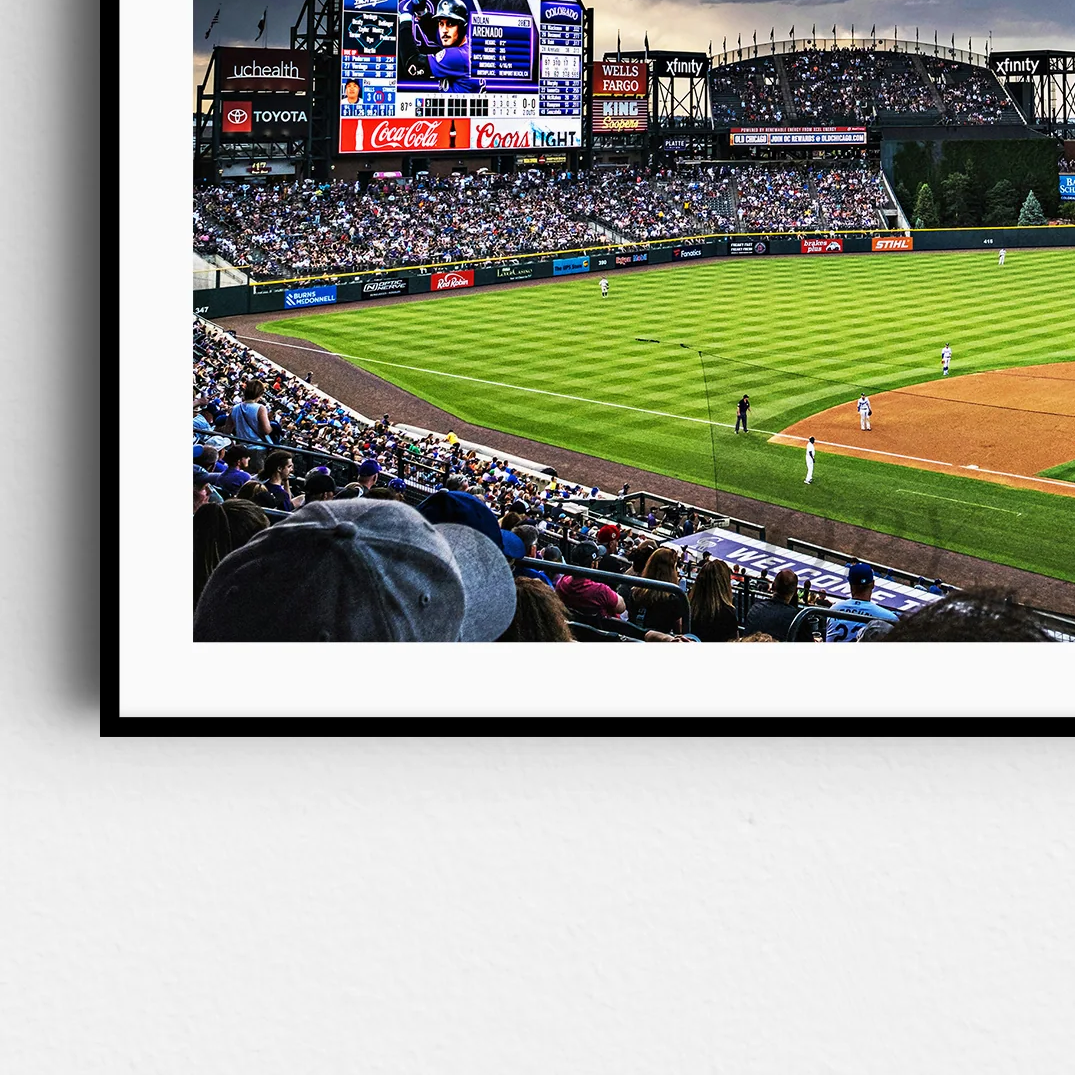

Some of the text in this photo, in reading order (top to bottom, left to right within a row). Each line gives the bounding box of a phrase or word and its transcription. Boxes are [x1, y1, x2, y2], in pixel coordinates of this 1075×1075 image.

[545, 6, 579, 21] COLORADO
[473, 17, 490, 25] NOLAN
[472, 27, 503, 38] ARENADO
[234, 60, 299, 79] uchealth
[602, 64, 639, 77] WELLS
[666, 58, 703, 77] xfinity
[996, 57, 1040, 75] xfinity
[602, 79, 639, 92] FARGO
[366, 92, 393, 102] 3 8
[522, 98, 536, 109] 0-0
[602, 101, 639, 116] KING
[253, 111, 308, 123] TOYOTA
[602, 116, 639, 132] Soopers
[371, 121, 442, 149] Coca-Cola
[476, 122, 577, 149] Coors LIGHT
[745, 135, 767, 143] CHICAGO
[770, 135, 783, 143] JOIN
[821, 134, 864, 142] OLDCHICAGO.COM
[875, 240, 909, 250] STIHL
[632, 253, 648, 262] Mobil
[680, 249, 702, 258] Fanatics
[437, 278, 469, 289] Red Robin
[293, 291, 317, 300] BURNS
[195, 306, 210, 314] 347
